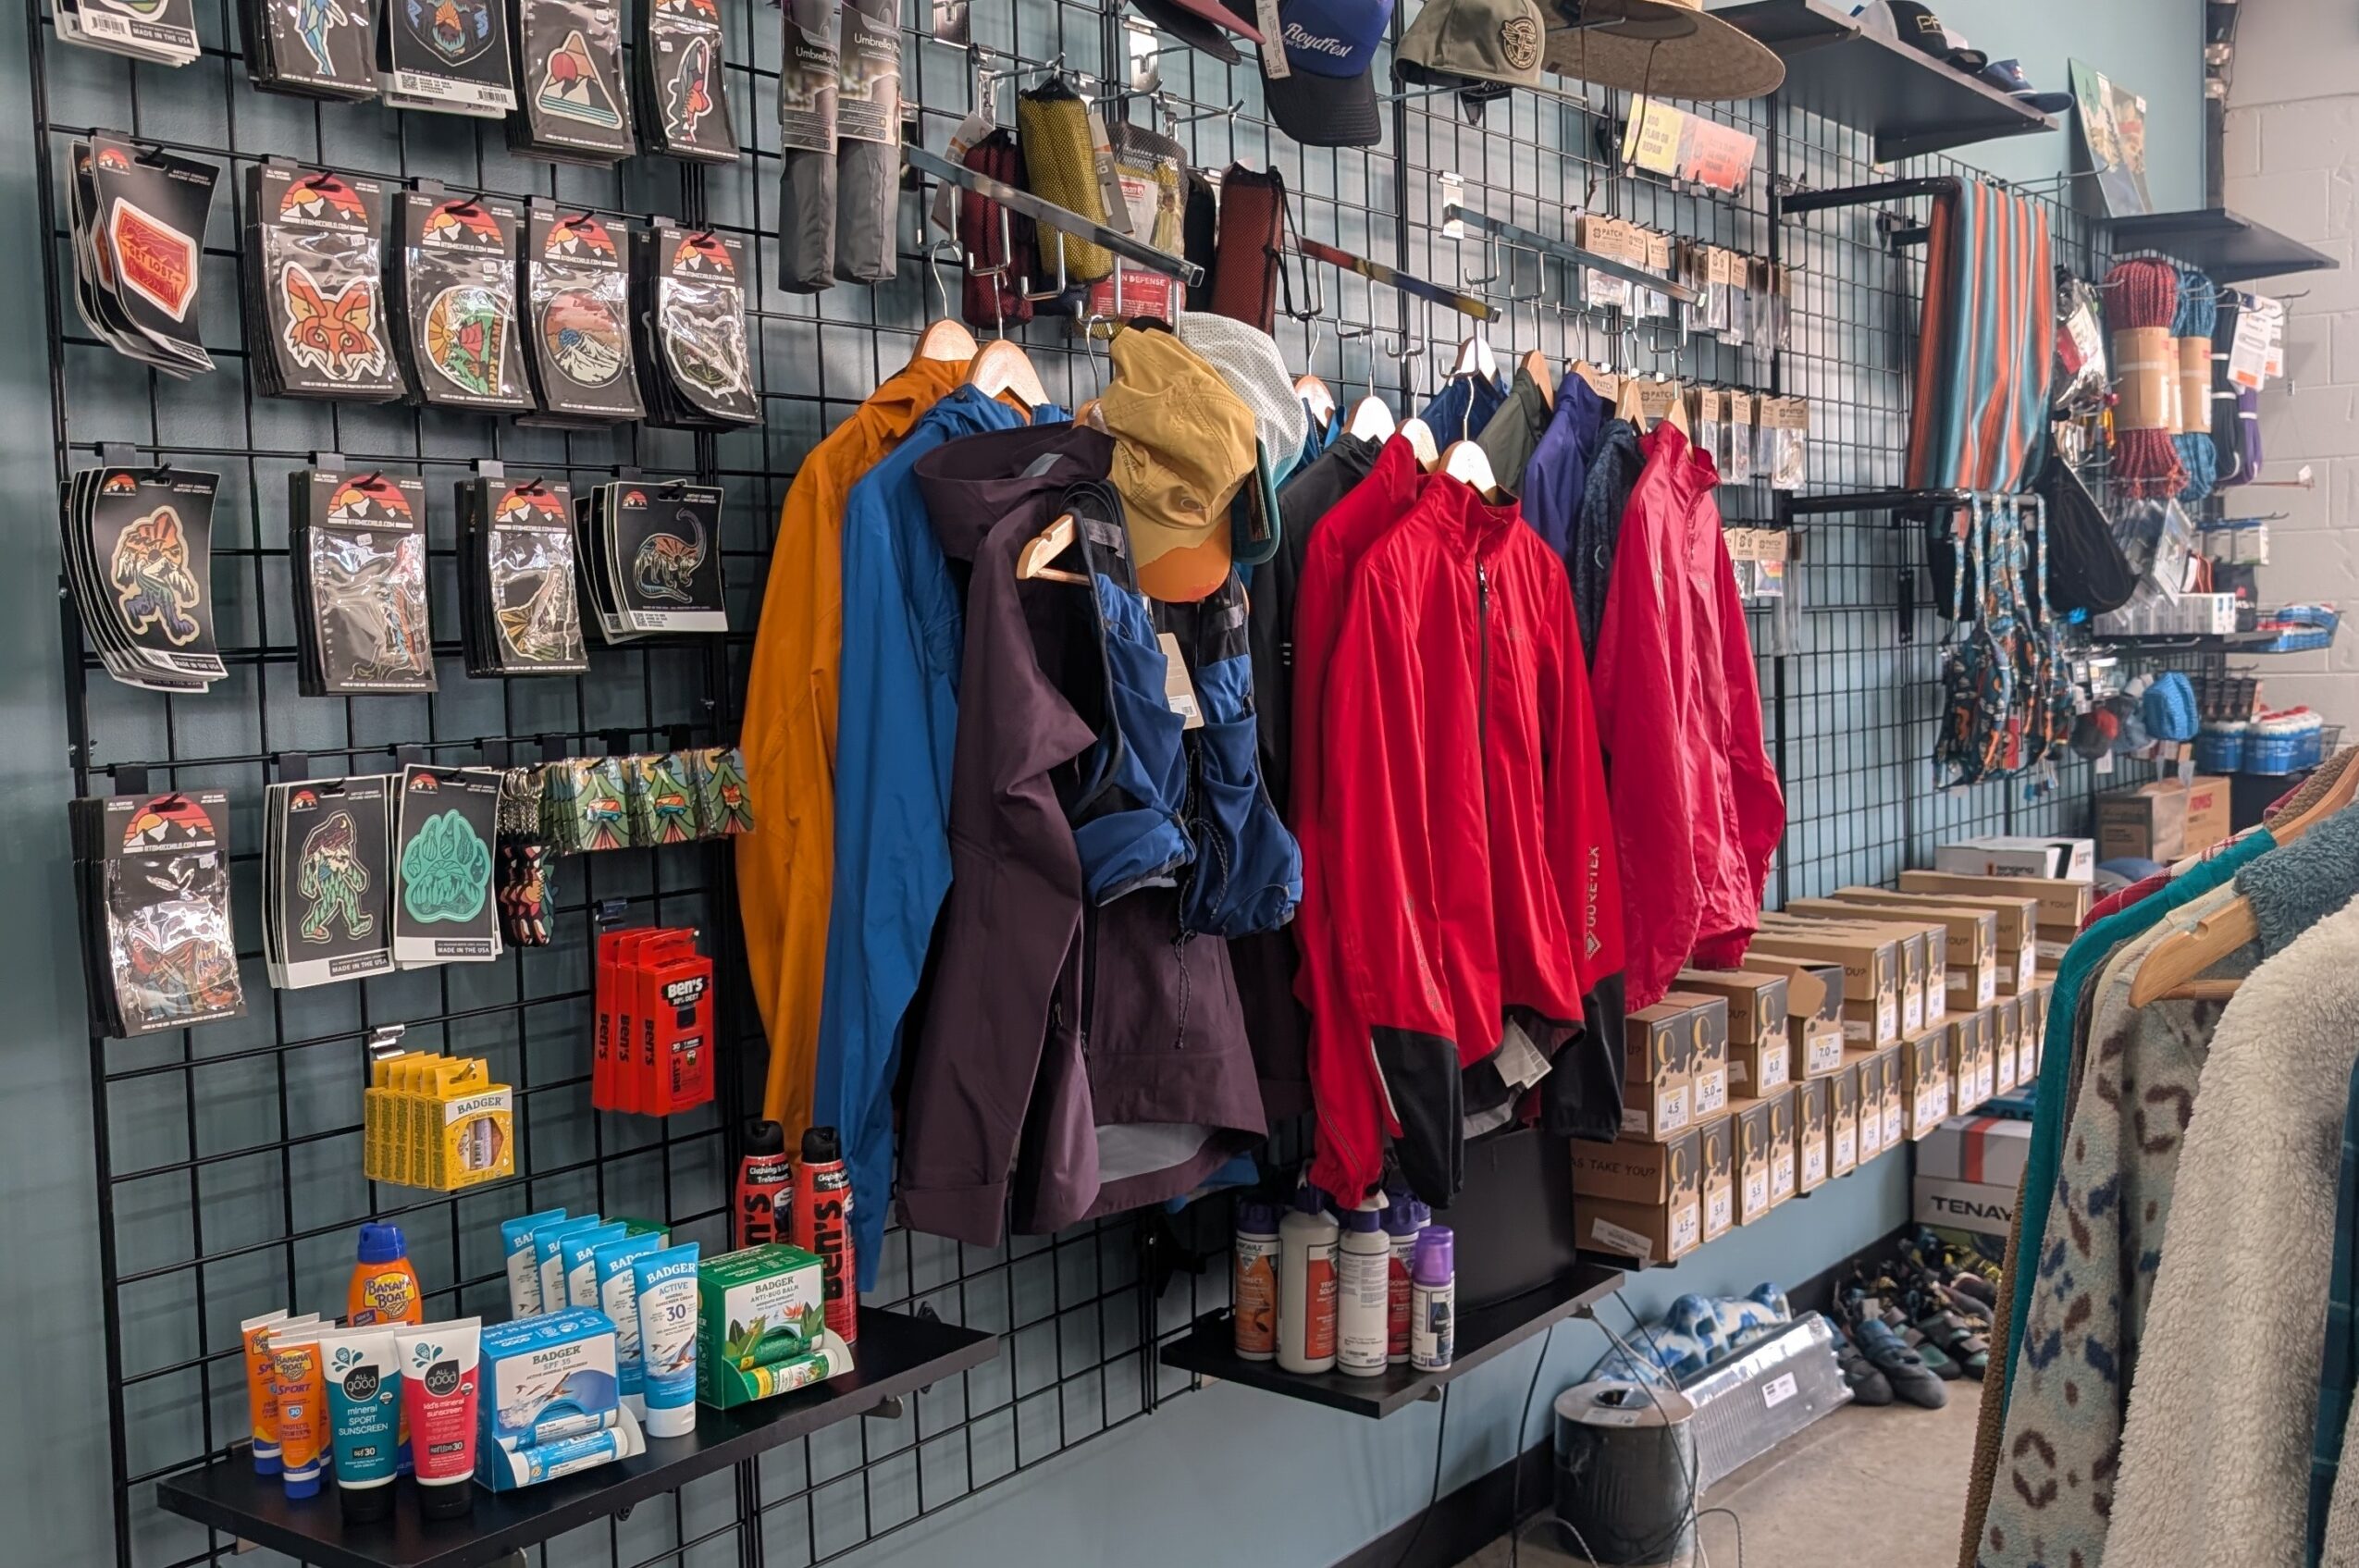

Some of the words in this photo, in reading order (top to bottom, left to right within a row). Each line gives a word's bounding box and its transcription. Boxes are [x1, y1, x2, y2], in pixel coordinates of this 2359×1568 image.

[133, 28, 152, 39] MADE
[154, 31, 163, 40] IN
[165, 33, 177, 42] THE
[178, 35, 192, 44] USA
[855, 32, 892, 49] Umbrella
[1285, 22, 1353, 57] FloydFest
[796, 46, 832, 63] Umbrella
[130, 244, 146, 263] GET
[150, 258, 174, 279] LOST
[1129, 276, 1166, 287] DEFENSE
[1587, 846, 1599, 928] GORE-TEX
[332, 964, 352, 973] MADE
[375, 958, 388, 967] USA
[668, 977, 703, 999] Ben's
[599, 1013, 610, 1060] Ben's
[619, 1014, 630, 1062] Ben's
[645, 1019, 655, 1067] Ben's
[1819, 1047, 1830, 1058] 7.0
[1769, 1060, 1780, 1073] 6.0
[1704, 1086, 1715, 1098] 5.0
[457, 1096, 502, 1115] BADGER
[1667, 1102, 1680, 1115] 4.5
[749, 1164, 777, 1175] Clothing
[1590, 1159, 1619, 1173] TAKE
[1626, 1166, 1656, 1177] YOU?
[1715, 1203, 1724, 1216] 5.0
[1932, 1195, 2013, 1221] TENAY
[744, 1193, 772, 1245] n's
[1679, 1219, 1689, 1233] 4.5
[814, 1199, 844, 1301] Ben's
[646, 1263, 696, 1284] BADGER
[364, 1278, 411, 1297] BANANA
[659, 1282, 688, 1297] ACTIVE
[755, 1277, 795, 1293] BADGER
[375, 1290, 408, 1310] BOAT
[750, 1290, 781, 1303] ANTI-BUG
[783, 1284, 799, 1294] BALM
[655, 1298, 679, 1308] SUNSCREEN
[666, 1303, 686, 1322] 30
[276, 1354, 309, 1366] BANANA
[533, 1345, 583, 1365] BADGER
[282, 1363, 303, 1376] BOAT
[543, 1360, 558, 1369] SPF
[562, 1362, 588, 1371] SUNSCREEN
[346, 1377, 377, 1393] good
[427, 1373, 457, 1388] good
[277, 1382, 311, 1395] SPORT
[348, 1406, 377, 1416] mineral
[424, 1401, 438, 1410] kid's
[438, 1398, 464, 1408] mineral
[426, 1406, 463, 1417] sunscreen
[290, 1408, 301, 1416] 30
[349, 1415, 377, 1426] SPORT
[339, 1423, 389, 1436] SUNSCREEN
[353, 1449, 364, 1459] spf
[364, 1447, 376, 1456] 30
[452, 1441, 463, 1451] 30
